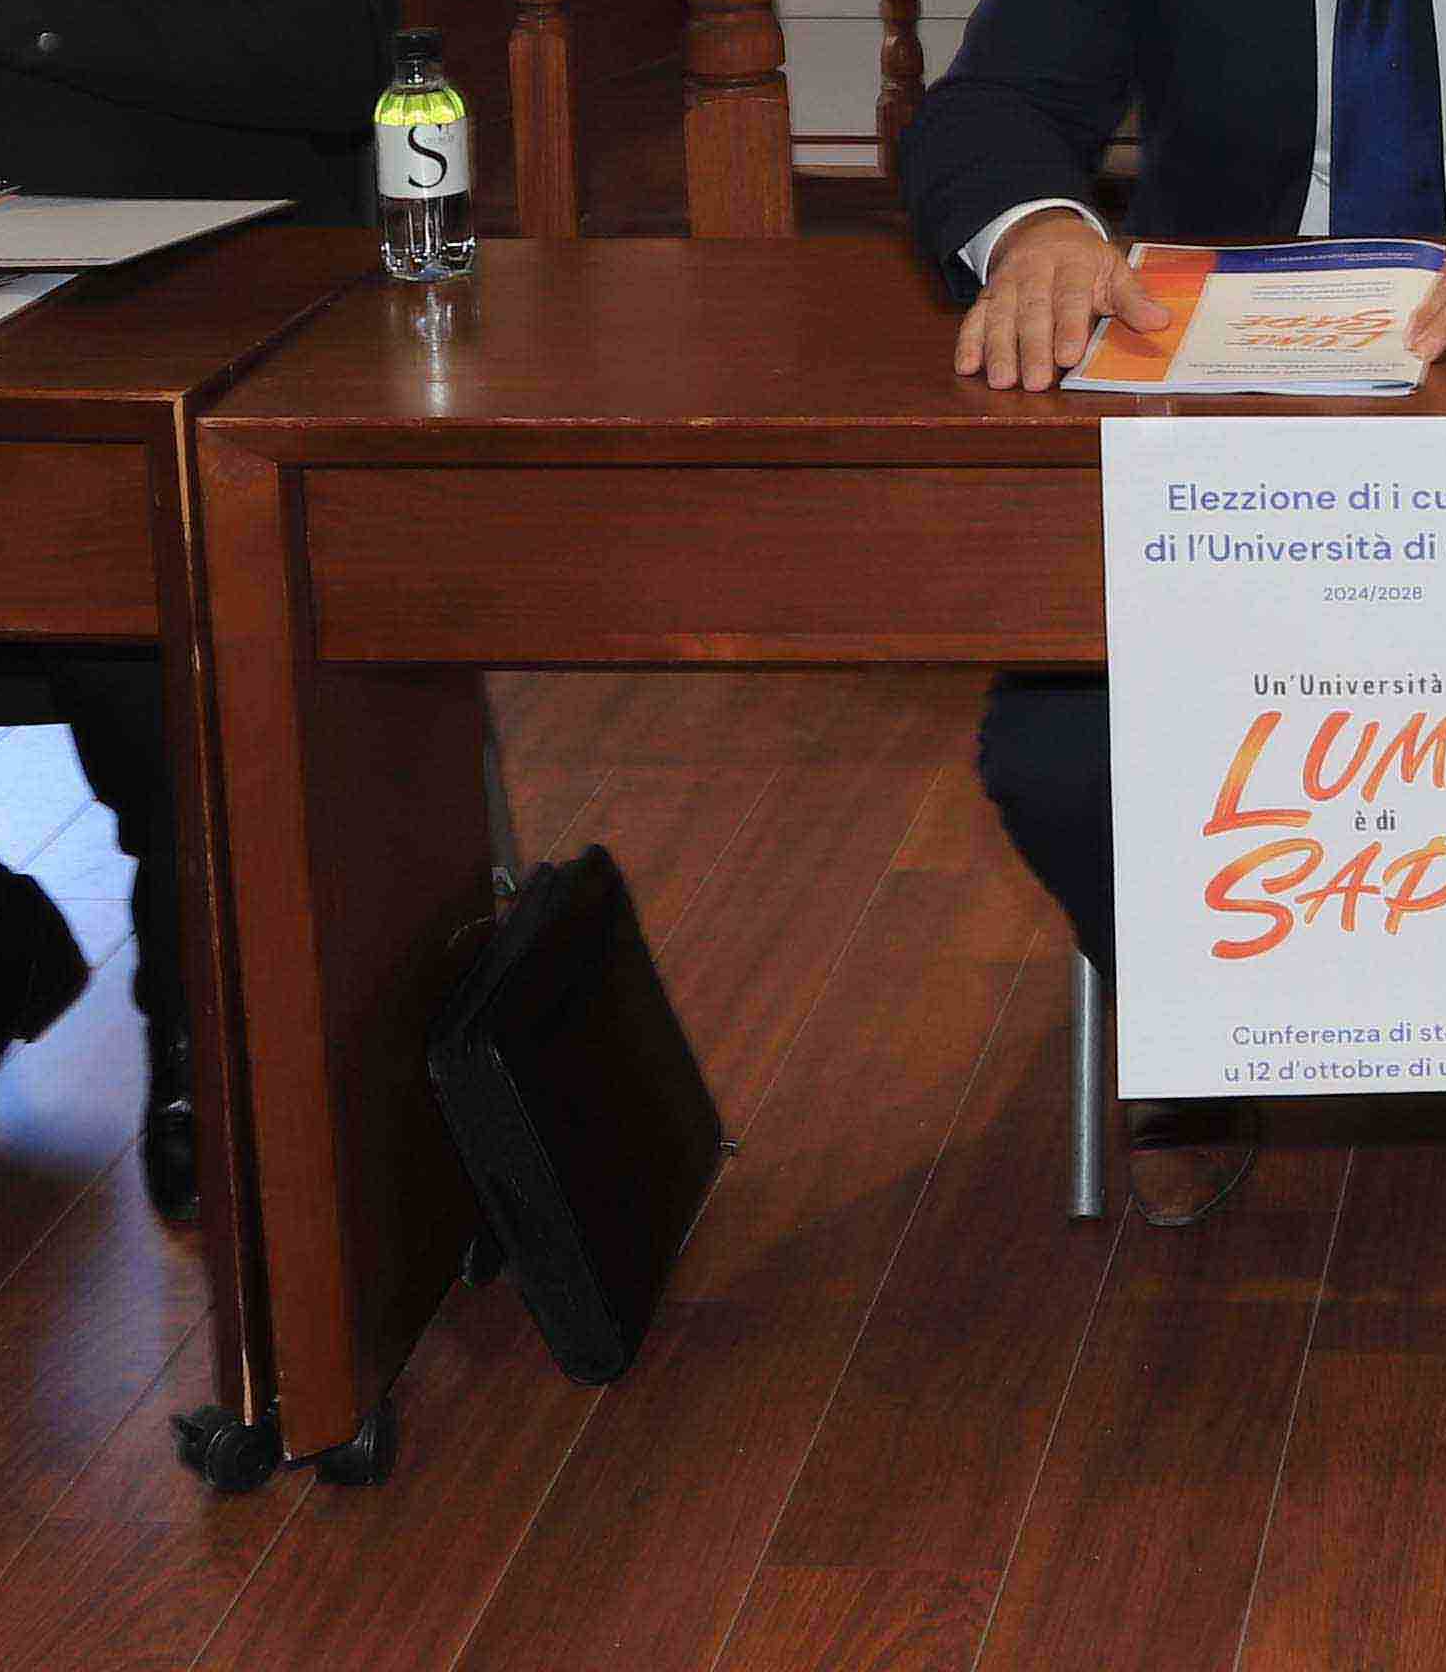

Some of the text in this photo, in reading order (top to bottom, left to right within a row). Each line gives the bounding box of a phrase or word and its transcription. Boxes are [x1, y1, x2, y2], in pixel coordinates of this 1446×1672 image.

[1169, 483, 1336, 511] Elezzione
[1349, 483, 1380, 510] di
[1393, 483, 1399, 512] i
[1145, 535, 1175, 561] di
[1189, 534, 1391, 561] l'Università
[1404, 533, 1435, 560] di
[1323, 584, 1423, 601] 2024/2028
[1255, 673, 1442, 695] Un'Università
[1355, 810, 1395, 830] è di
[1233, 1024, 1381, 1046] Cunferenza
[1389, 1022, 1411, 1042] di
[1225, 1064, 1239, 1082] u
[1248, 1062, 1274, 1081] 12
[1279, 1059, 1400, 1080] d'ottobre
[1409, 1058, 1431, 1080] di
